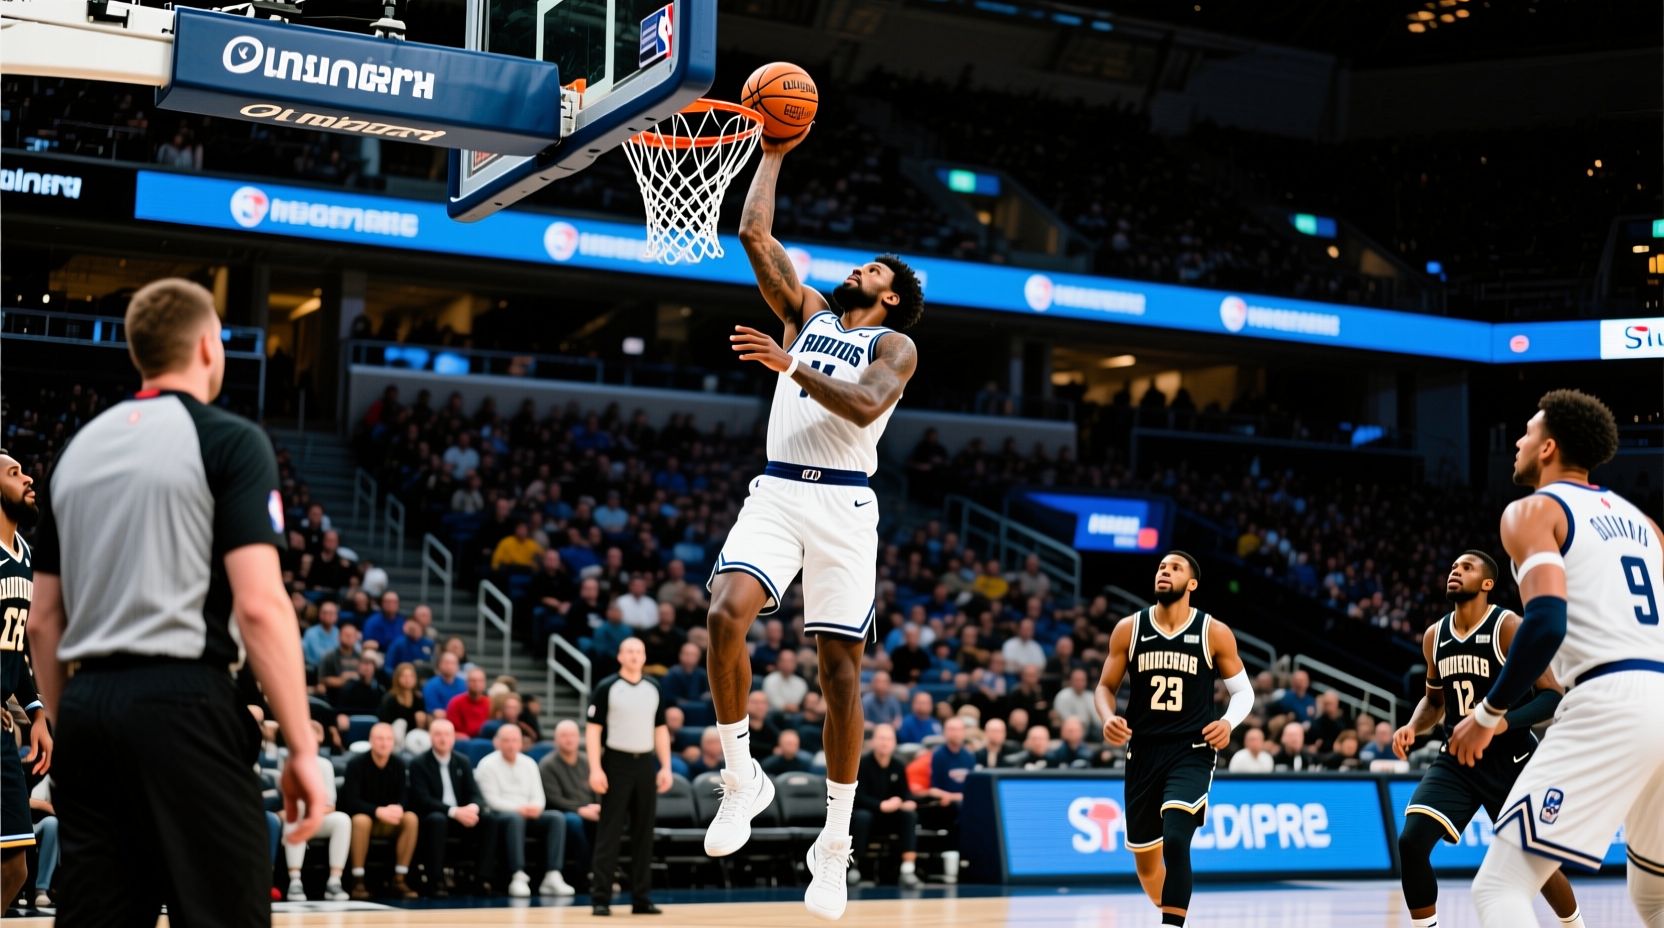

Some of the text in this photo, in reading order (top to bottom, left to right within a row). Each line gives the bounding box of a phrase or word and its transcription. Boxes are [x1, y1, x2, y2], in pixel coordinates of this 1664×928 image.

[1620, 555, 1659, 626] 9
[1150, 675, 1183, 712] 23
[1452, 680, 1476, 716] 12
